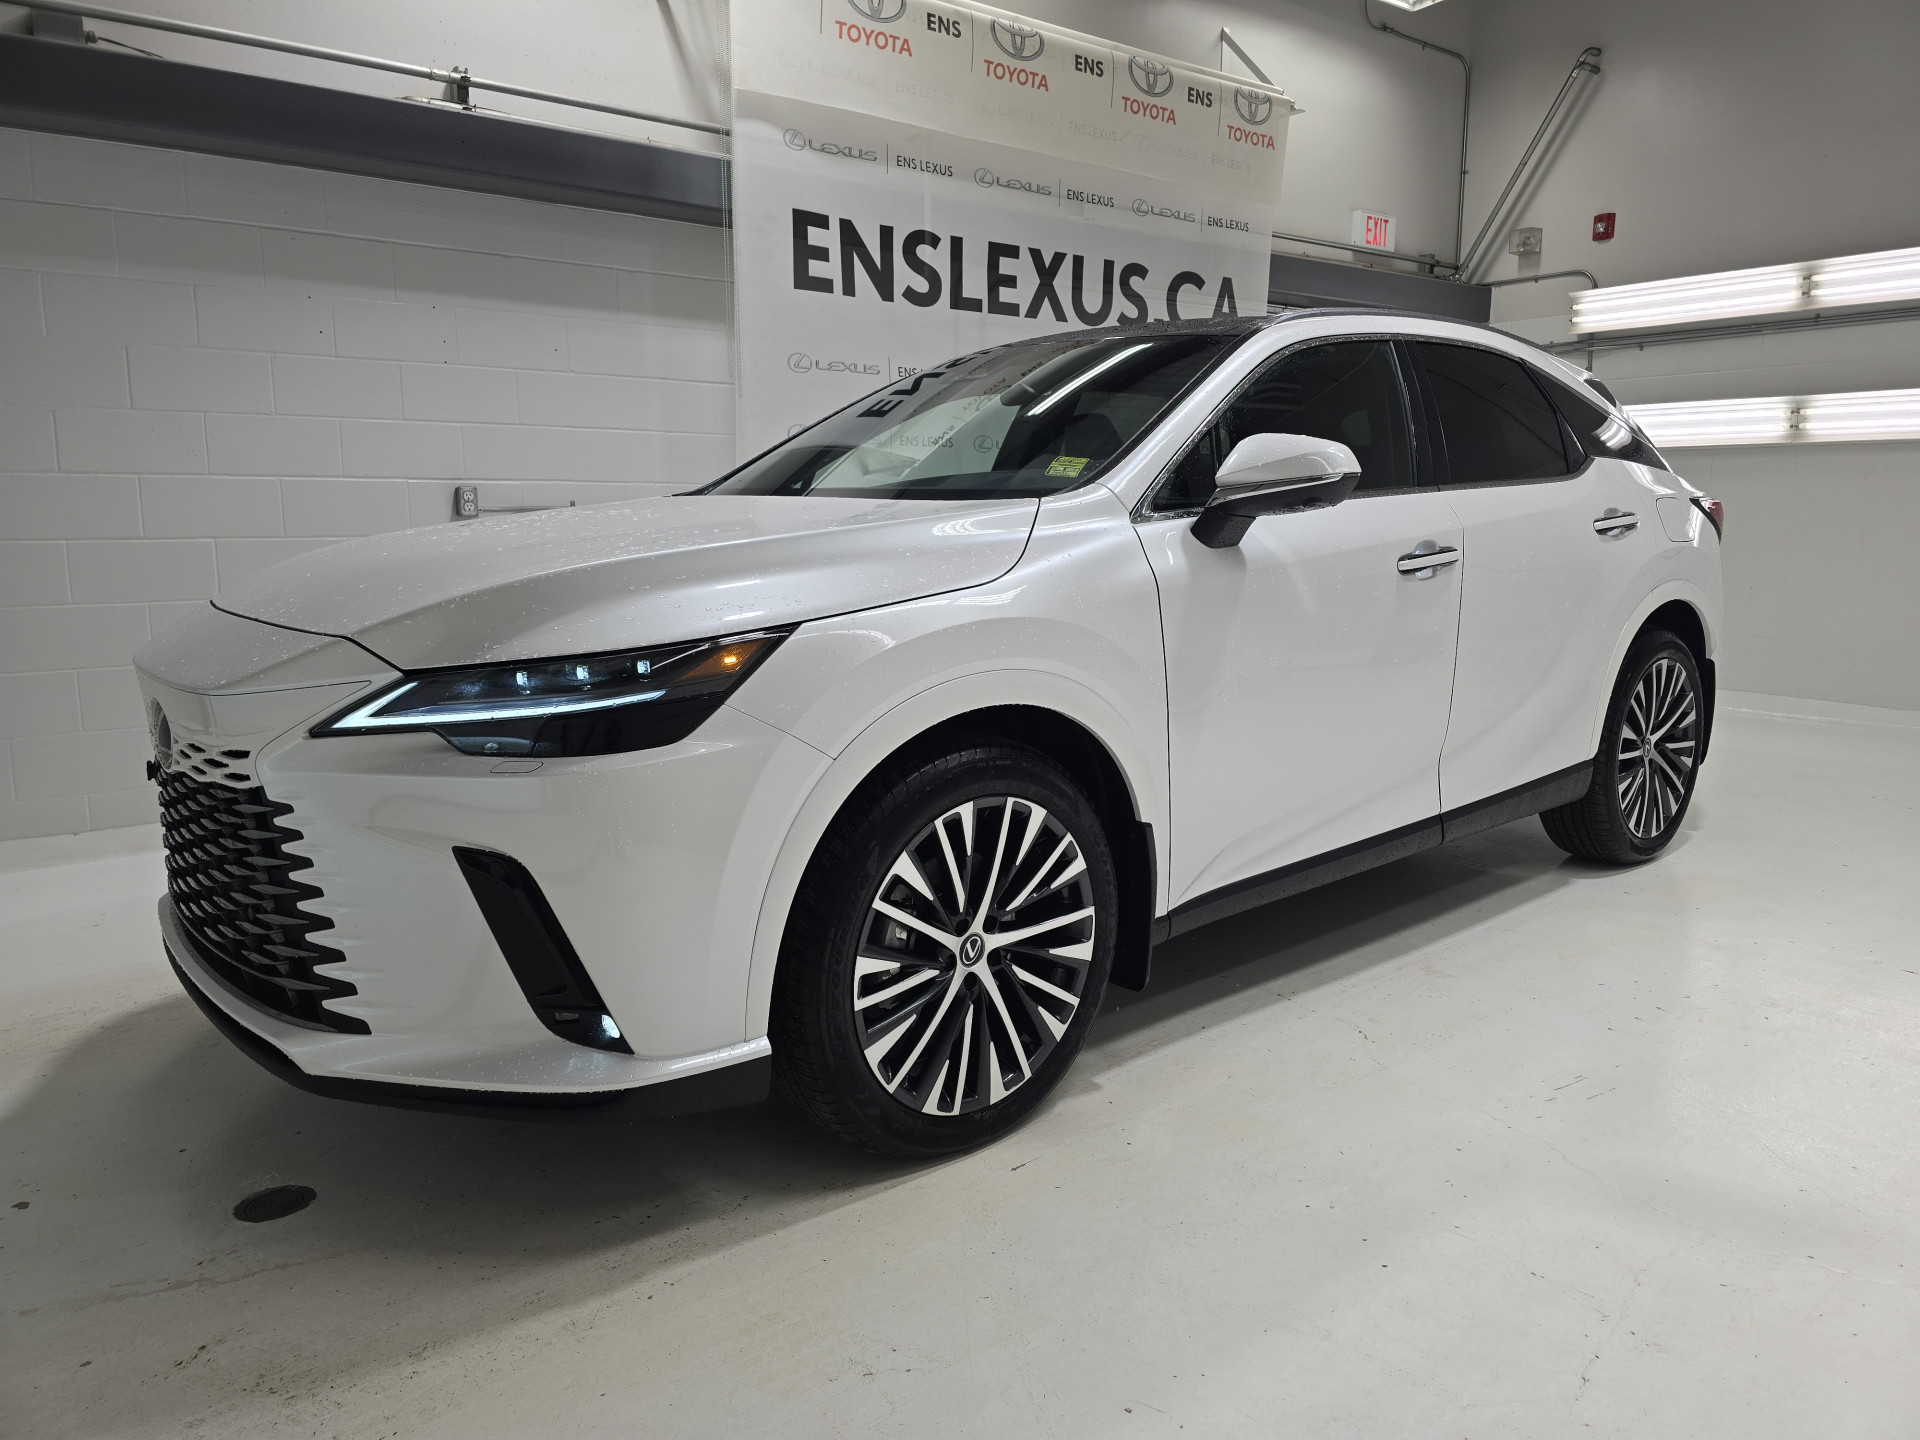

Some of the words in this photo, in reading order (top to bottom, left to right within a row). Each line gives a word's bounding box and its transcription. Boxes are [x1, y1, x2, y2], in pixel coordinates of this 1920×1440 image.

[926, 12, 962, 38] ENS
[835, 20, 913, 57] TOYOTA
[983, 59, 1049, 92] TOYOTA
[1074, 54, 1104, 78] ENS
[1187, 86, 1213, 108] ENS
[1121, 96, 1177, 125] TOYOTA
[1226, 124, 1275, 150] TOYOTA
[808, 138, 877, 162] LEXUS
[896, 155, 917, 169] ENS
[920, 158, 953, 177] LEXUS
[996, 175, 1052, 196] LEXUS
[1066, 189, 1084, 202] ENS
[1086, 192, 1115, 208] LEXUS
[1150, 207, 1196, 223] LEXUS
[1207, 216, 1223, 228] ENS
[1225, 218, 1249, 232] LEXUS
[1365, 215, 1389, 247] EXIT
[792, 207, 1239, 327] ENSLEXUSCA
[815, 359, 880, 375] LEXUS
[897, 366, 917, 378] ENS
